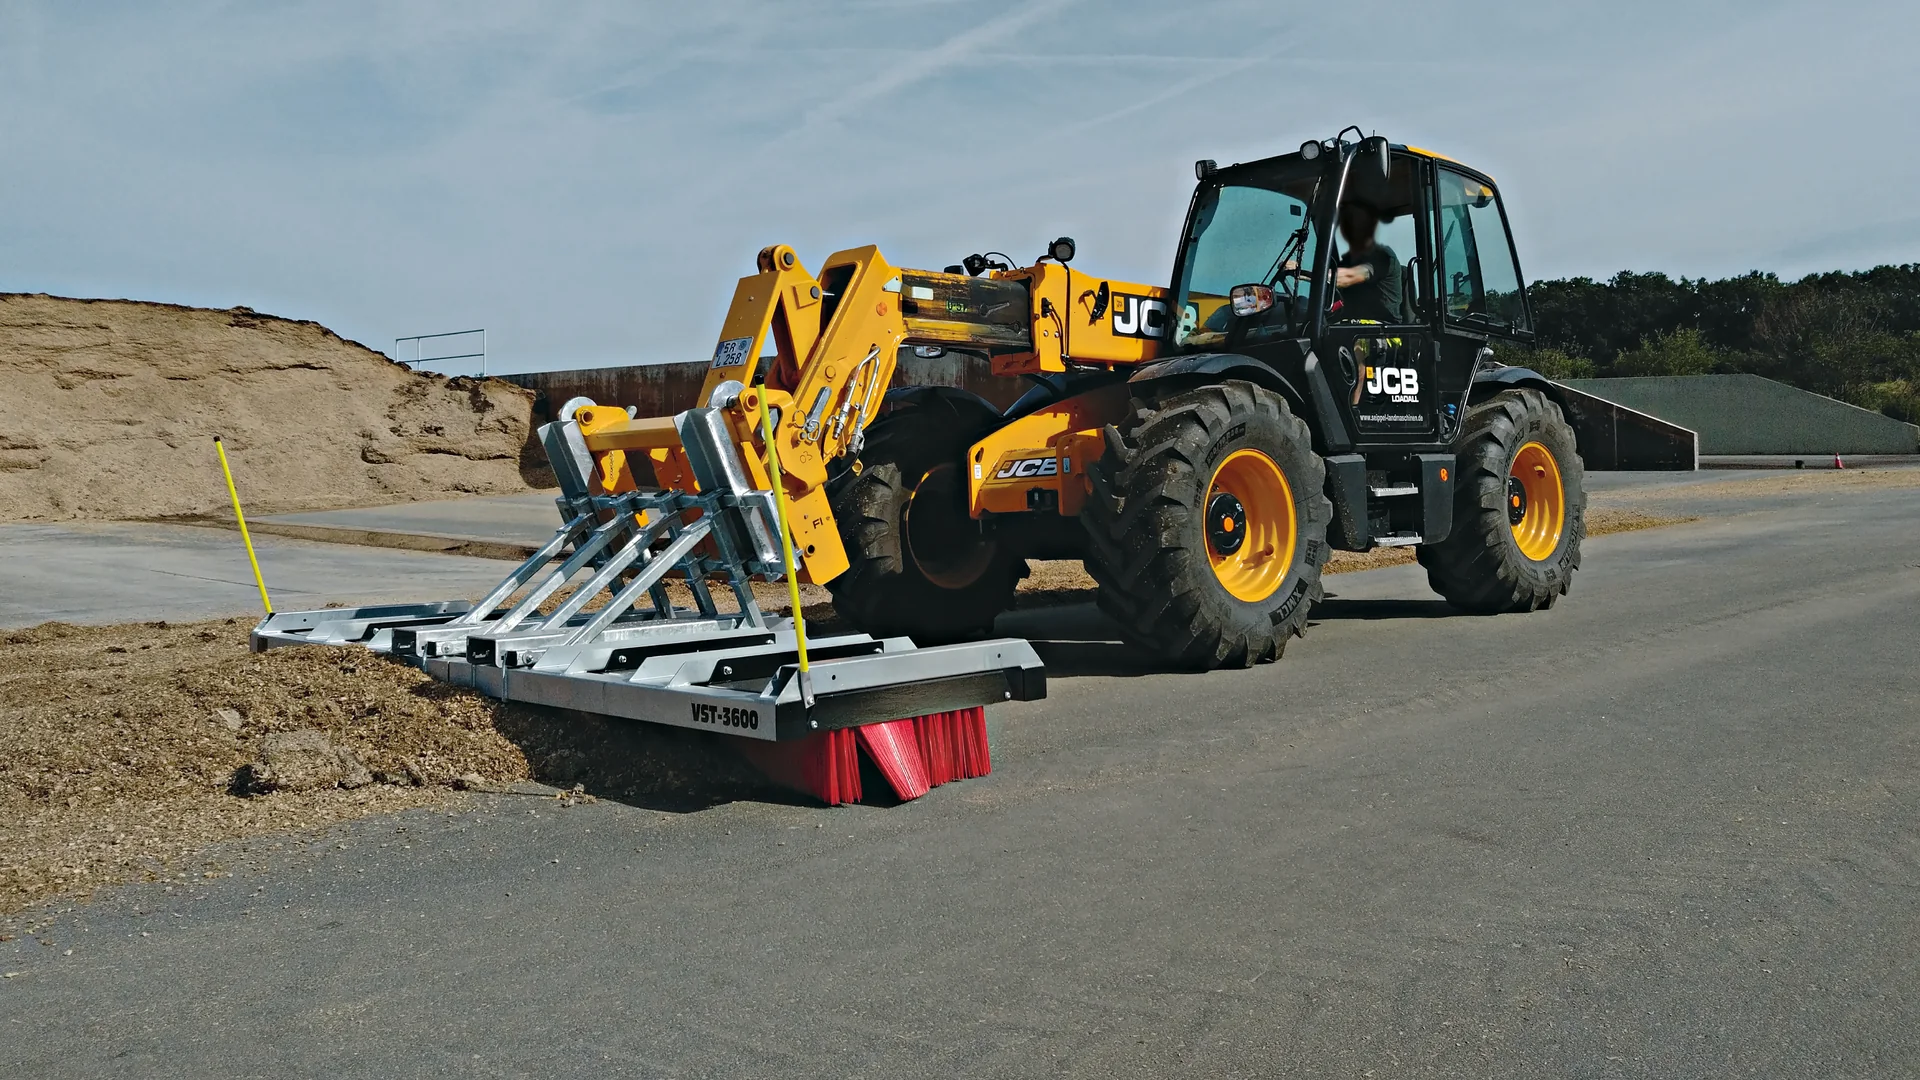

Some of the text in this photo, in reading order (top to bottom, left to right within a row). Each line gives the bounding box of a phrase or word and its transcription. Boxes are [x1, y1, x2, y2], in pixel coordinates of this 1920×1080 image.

[1114, 298, 1197, 346] JCB
[723, 353, 742, 365] 258
[1366, 367, 1419, 394] JCB
[997, 459, 1057, 478] JCB
[1276, 588, 1303, 620] XMCL
[691, 703, 758, 730] VST-3600
